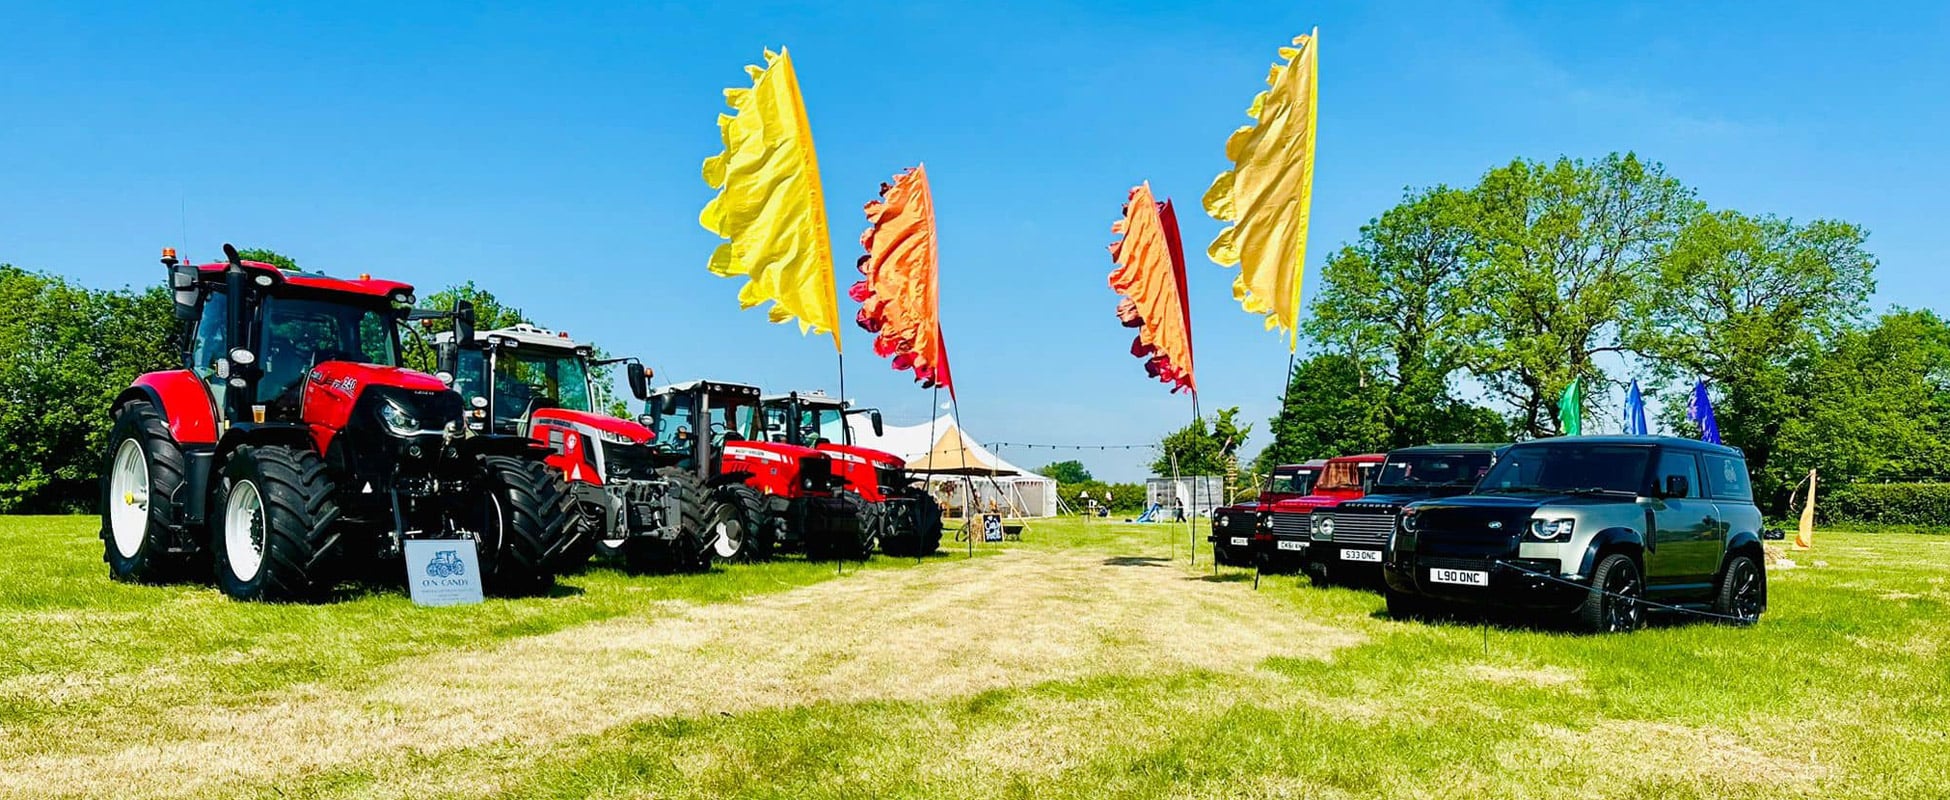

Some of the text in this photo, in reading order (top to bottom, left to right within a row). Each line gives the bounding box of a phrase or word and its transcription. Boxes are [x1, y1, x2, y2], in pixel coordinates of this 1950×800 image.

[1345, 550, 1376, 560] S33 ONC
[1437, 569, 1480, 583] L90 ONC
